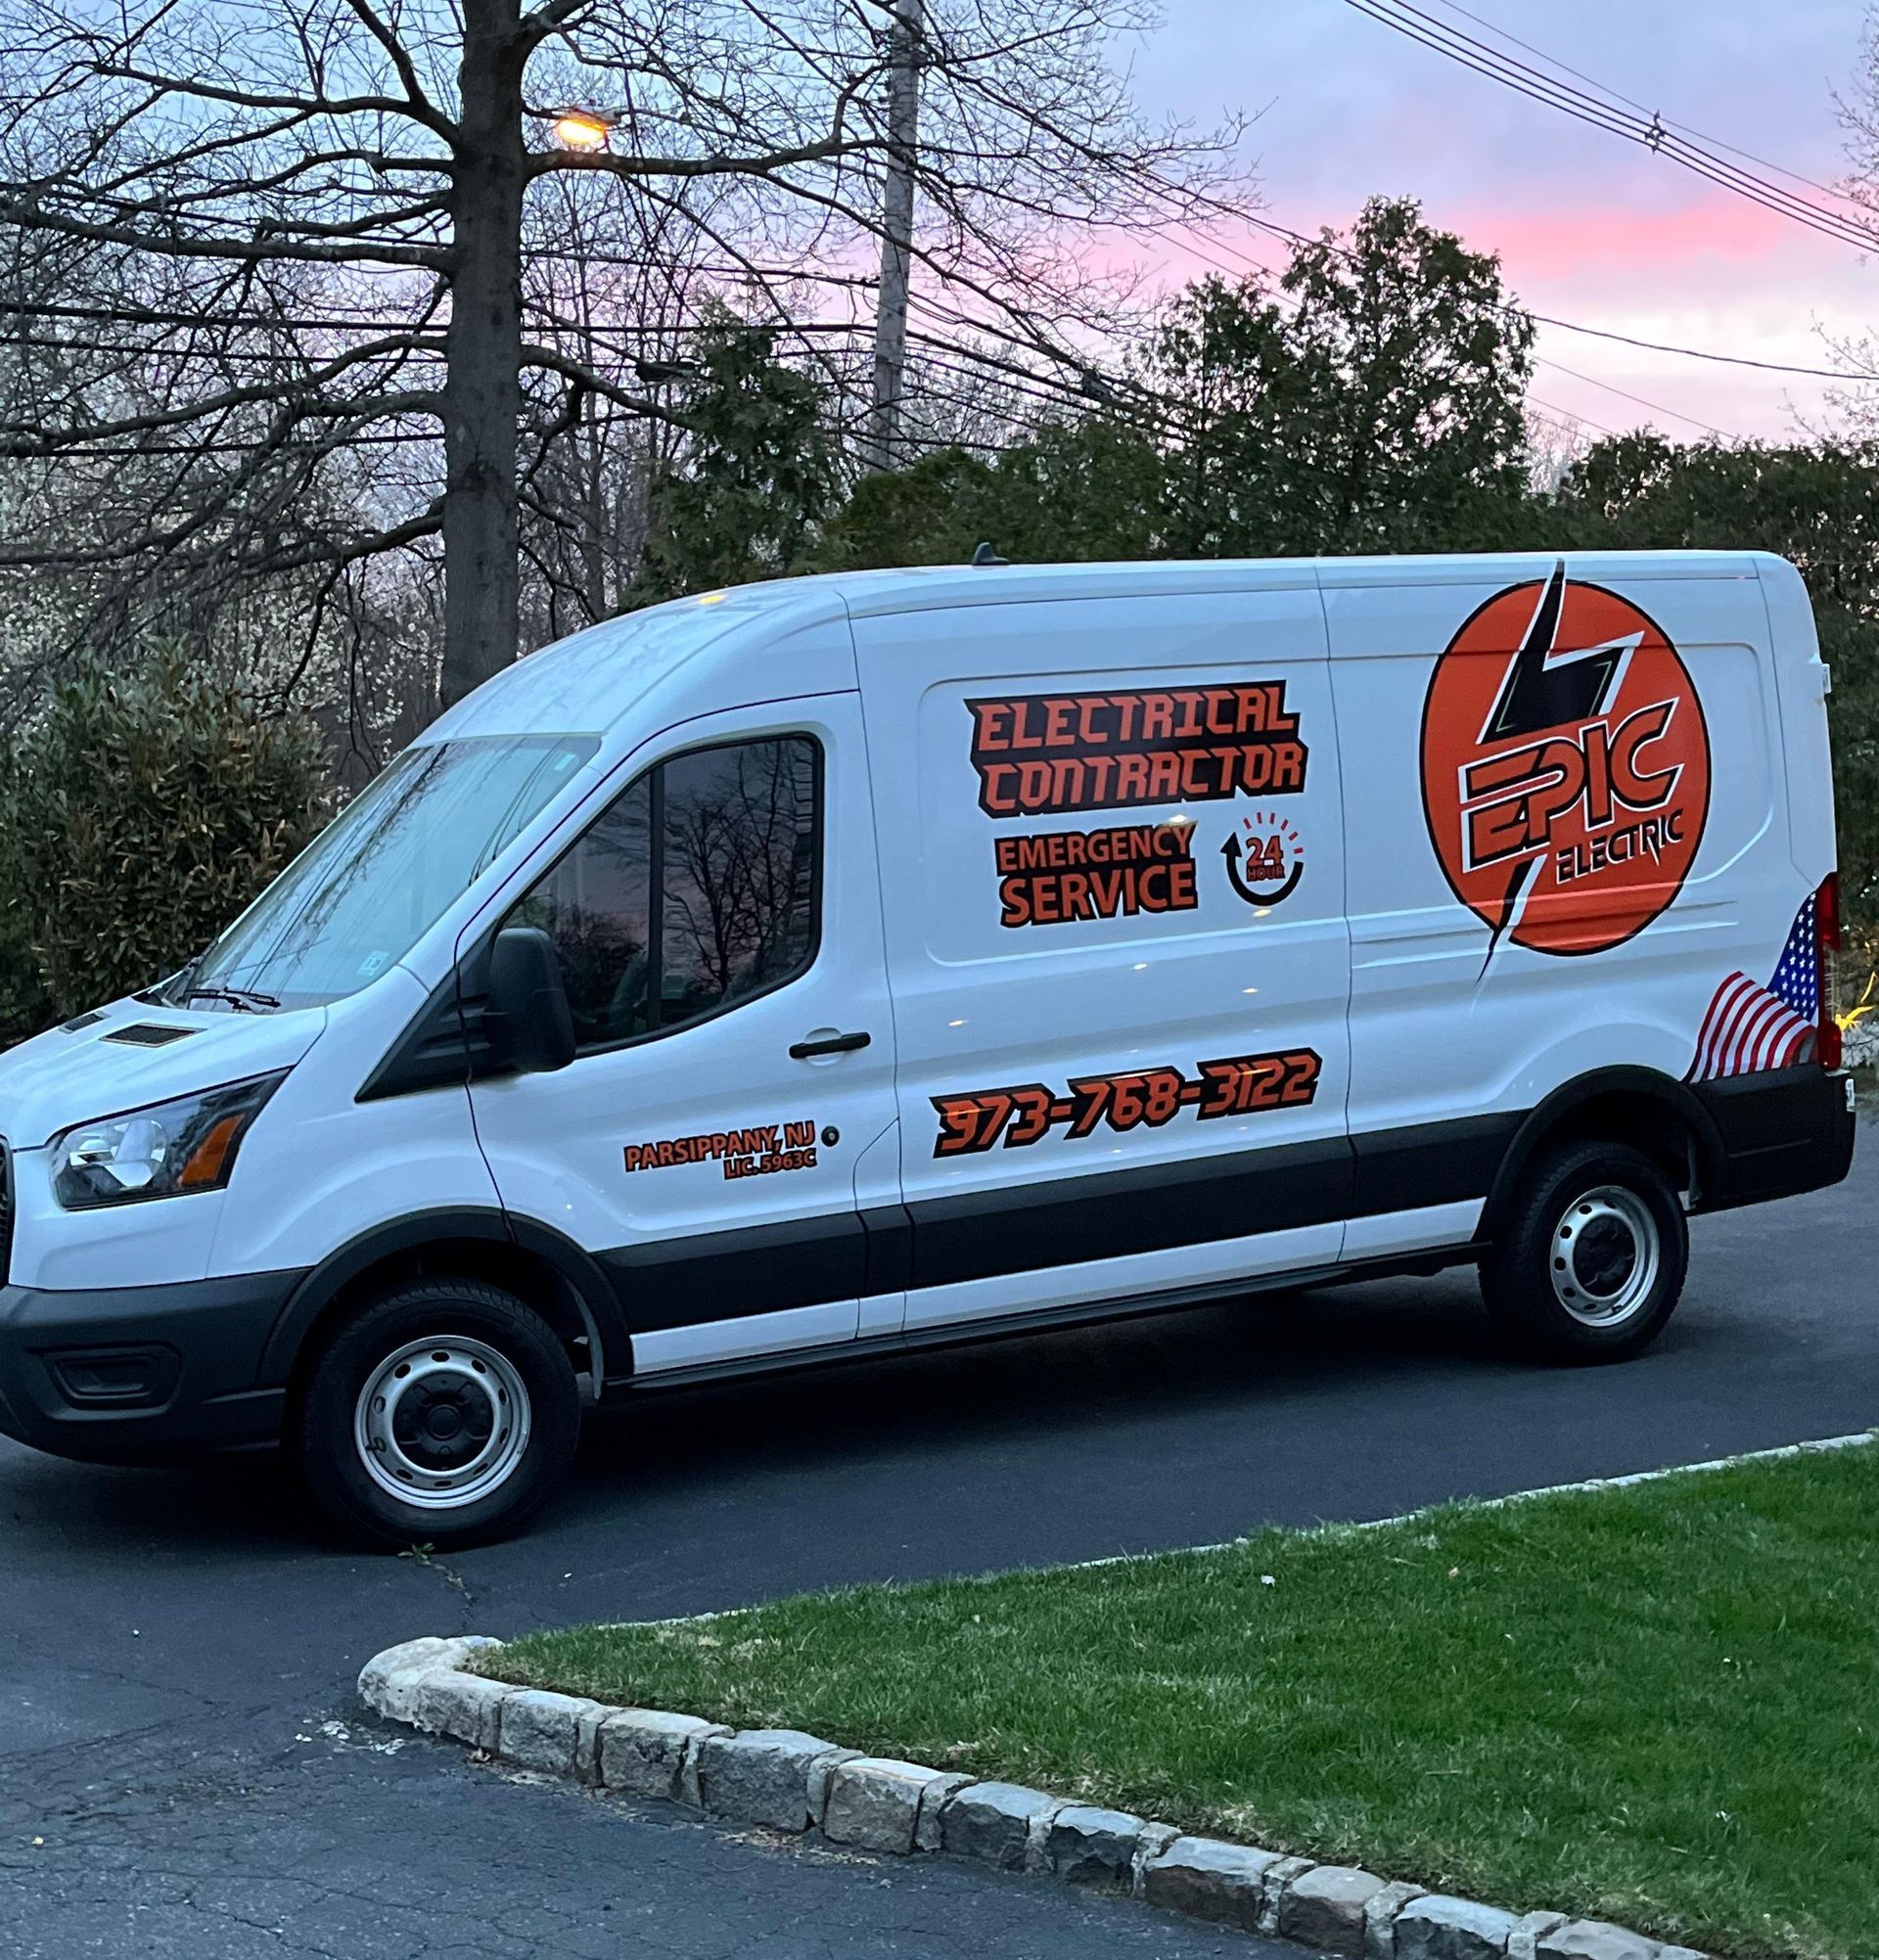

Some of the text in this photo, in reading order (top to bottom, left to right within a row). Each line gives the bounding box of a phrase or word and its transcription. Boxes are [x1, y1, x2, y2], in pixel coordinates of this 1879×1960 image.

[976, 686, 1295, 751] ELECTRICAL
[982, 741, 1306, 810] CONTRACTOR
[1457, 697, 1684, 873] EPIC
[997, 827, 1194, 872] EMERGENCY
[1246, 835, 1283, 867] 24
[1247, 867, 1285, 881] HOUR
[1556, 809, 1683, 885] ELECTRIC
[1004, 862, 1195, 924] SERVICE
[939, 1053, 1317, 1151] 973-768-3122
[624, 1121, 816, 1171] PARSIPPANY, NJ
[724, 1149, 816, 1178] LIC. 5963C
